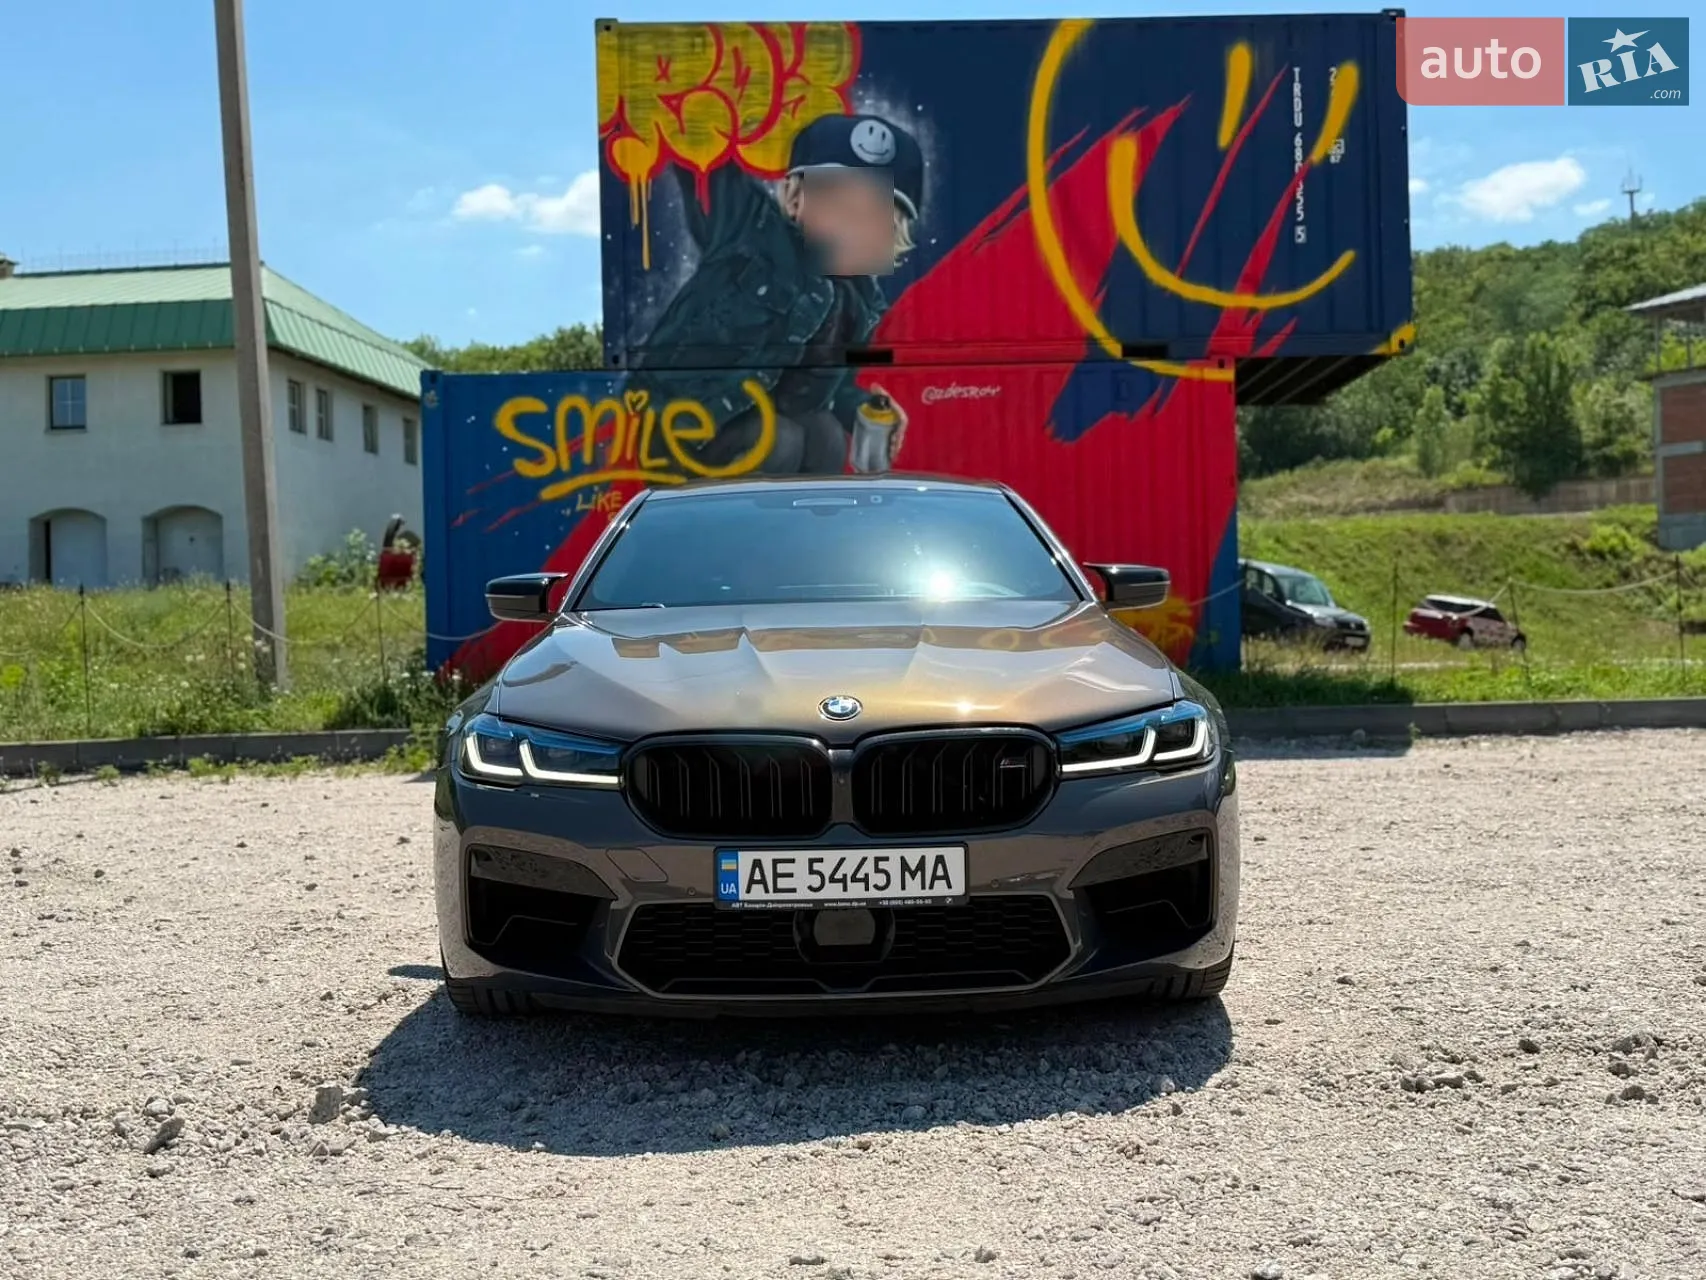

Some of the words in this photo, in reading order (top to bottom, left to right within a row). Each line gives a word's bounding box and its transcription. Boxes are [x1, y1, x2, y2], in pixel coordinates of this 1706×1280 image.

[745, 857, 797, 894] AE
[806, 855, 892, 893] 5445
[900, 854, 953, 891] MA
[720, 883, 737, 895] UA
